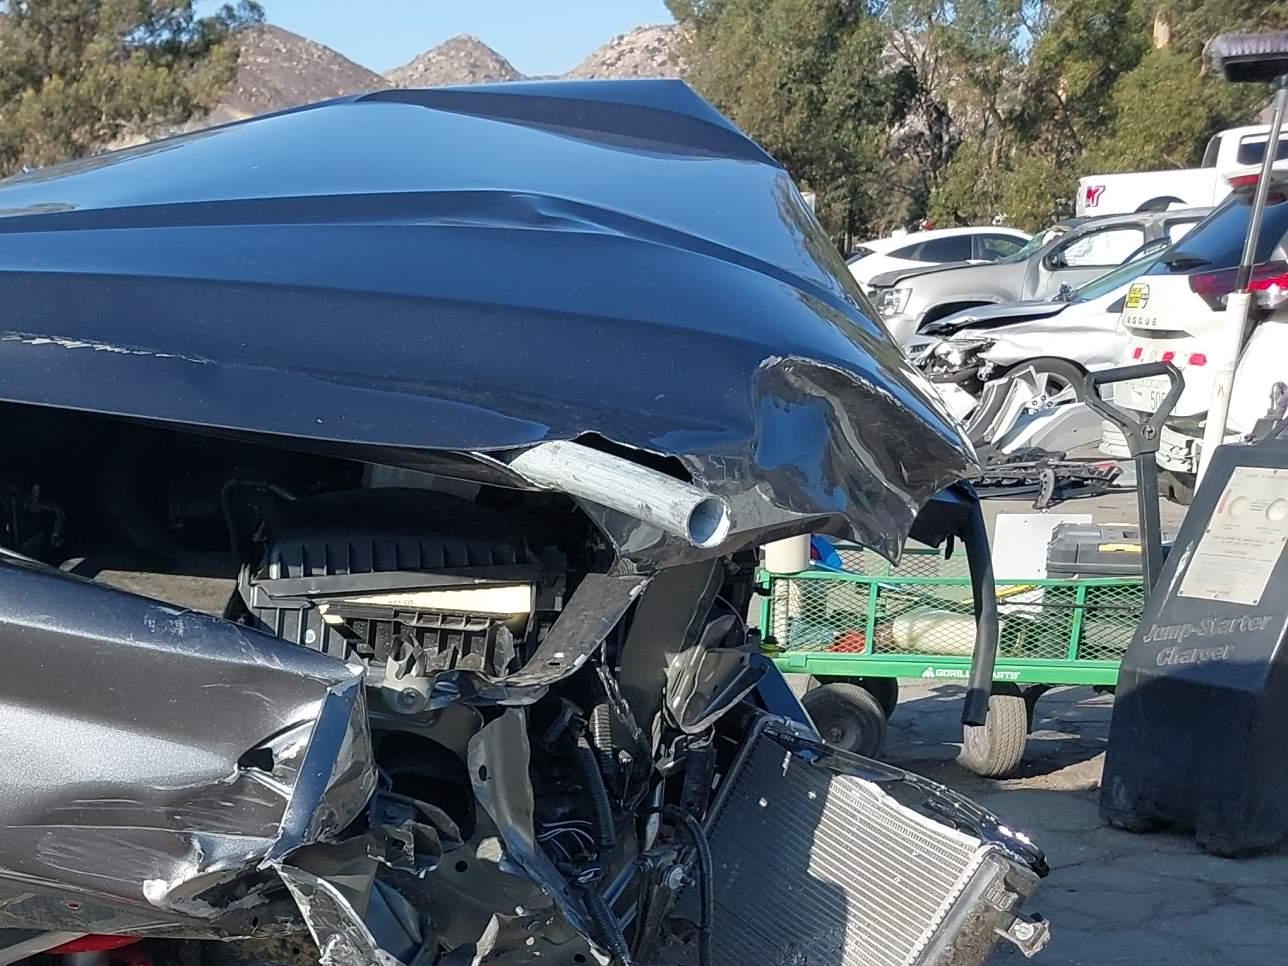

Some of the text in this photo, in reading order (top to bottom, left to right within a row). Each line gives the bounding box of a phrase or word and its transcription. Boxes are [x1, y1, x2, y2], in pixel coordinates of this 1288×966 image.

[1142, 615, 1272, 643] Jump-Starter
[1156, 645, 1230, 666] Charger
[935, 669, 970, 677] GORILL
